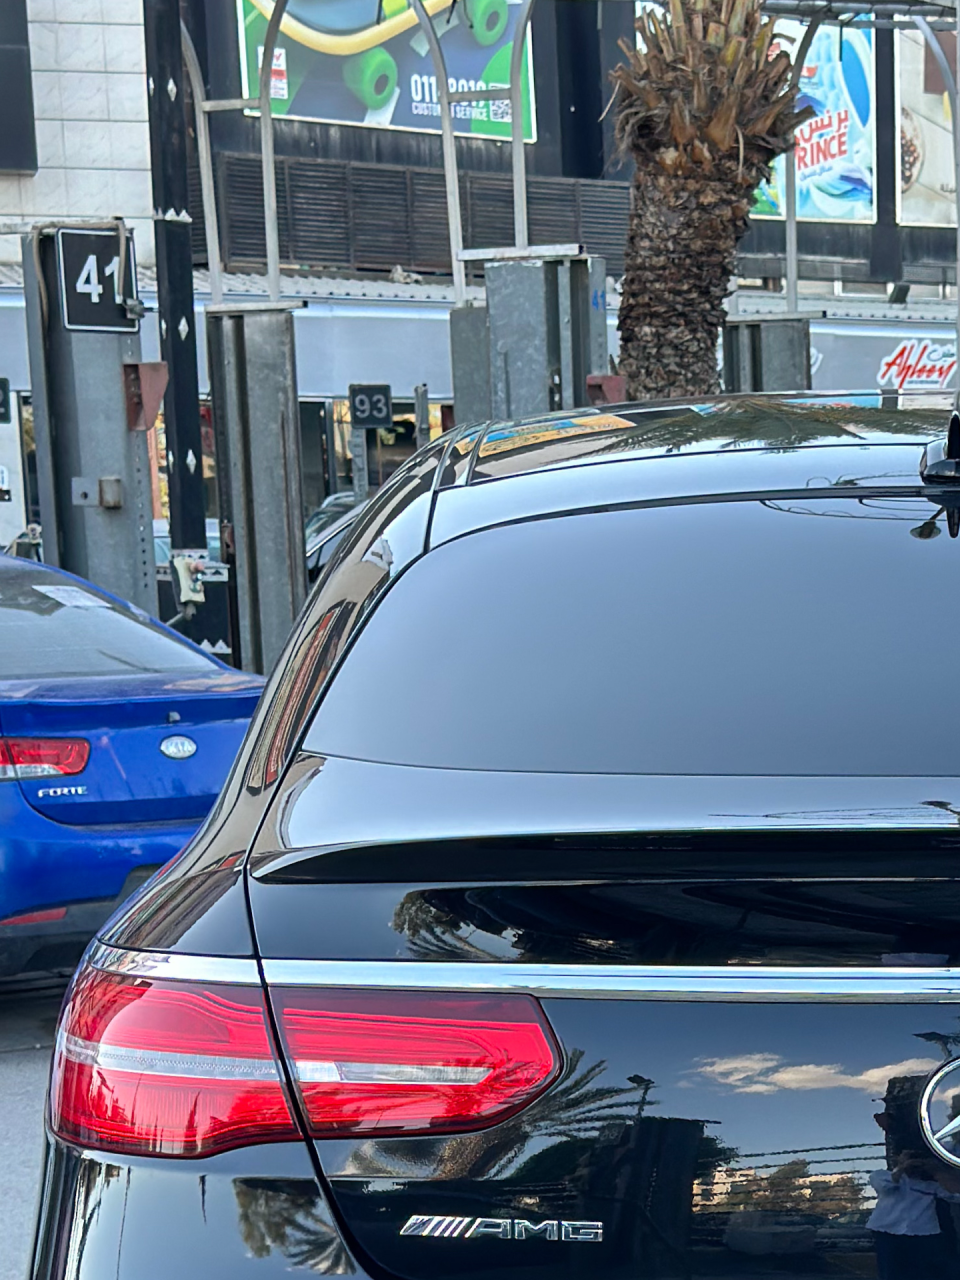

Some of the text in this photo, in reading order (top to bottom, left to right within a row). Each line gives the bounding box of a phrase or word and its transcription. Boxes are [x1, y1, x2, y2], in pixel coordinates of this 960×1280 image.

[795, 131, 848, 171] RINCE
[76, 254, 123, 304] 41
[355, 394, 387, 418] 93
[166, 740, 192, 753] KIA
[37, 786, 88, 798] FORTE
